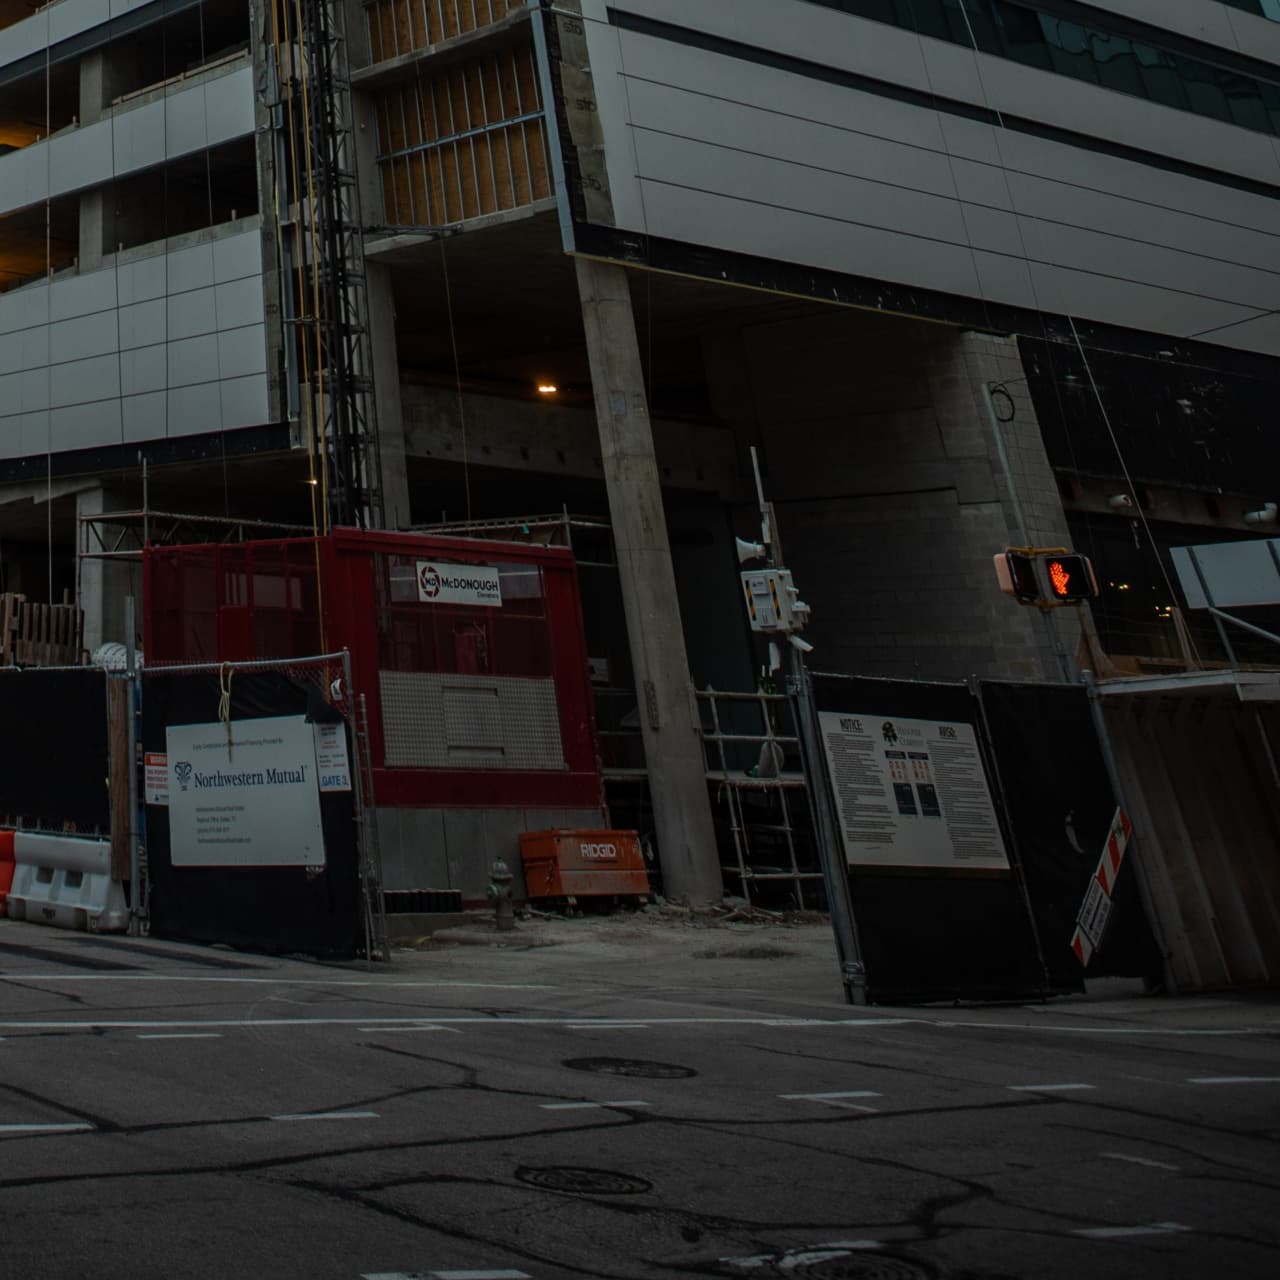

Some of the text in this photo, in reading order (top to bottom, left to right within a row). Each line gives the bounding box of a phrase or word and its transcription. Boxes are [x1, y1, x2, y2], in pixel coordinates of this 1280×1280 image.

[441, 577, 498, 591] McDONOUGH
[194, 765, 305, 788] Northwestern Mutual
[580, 844, 616, 858] RIDGID
